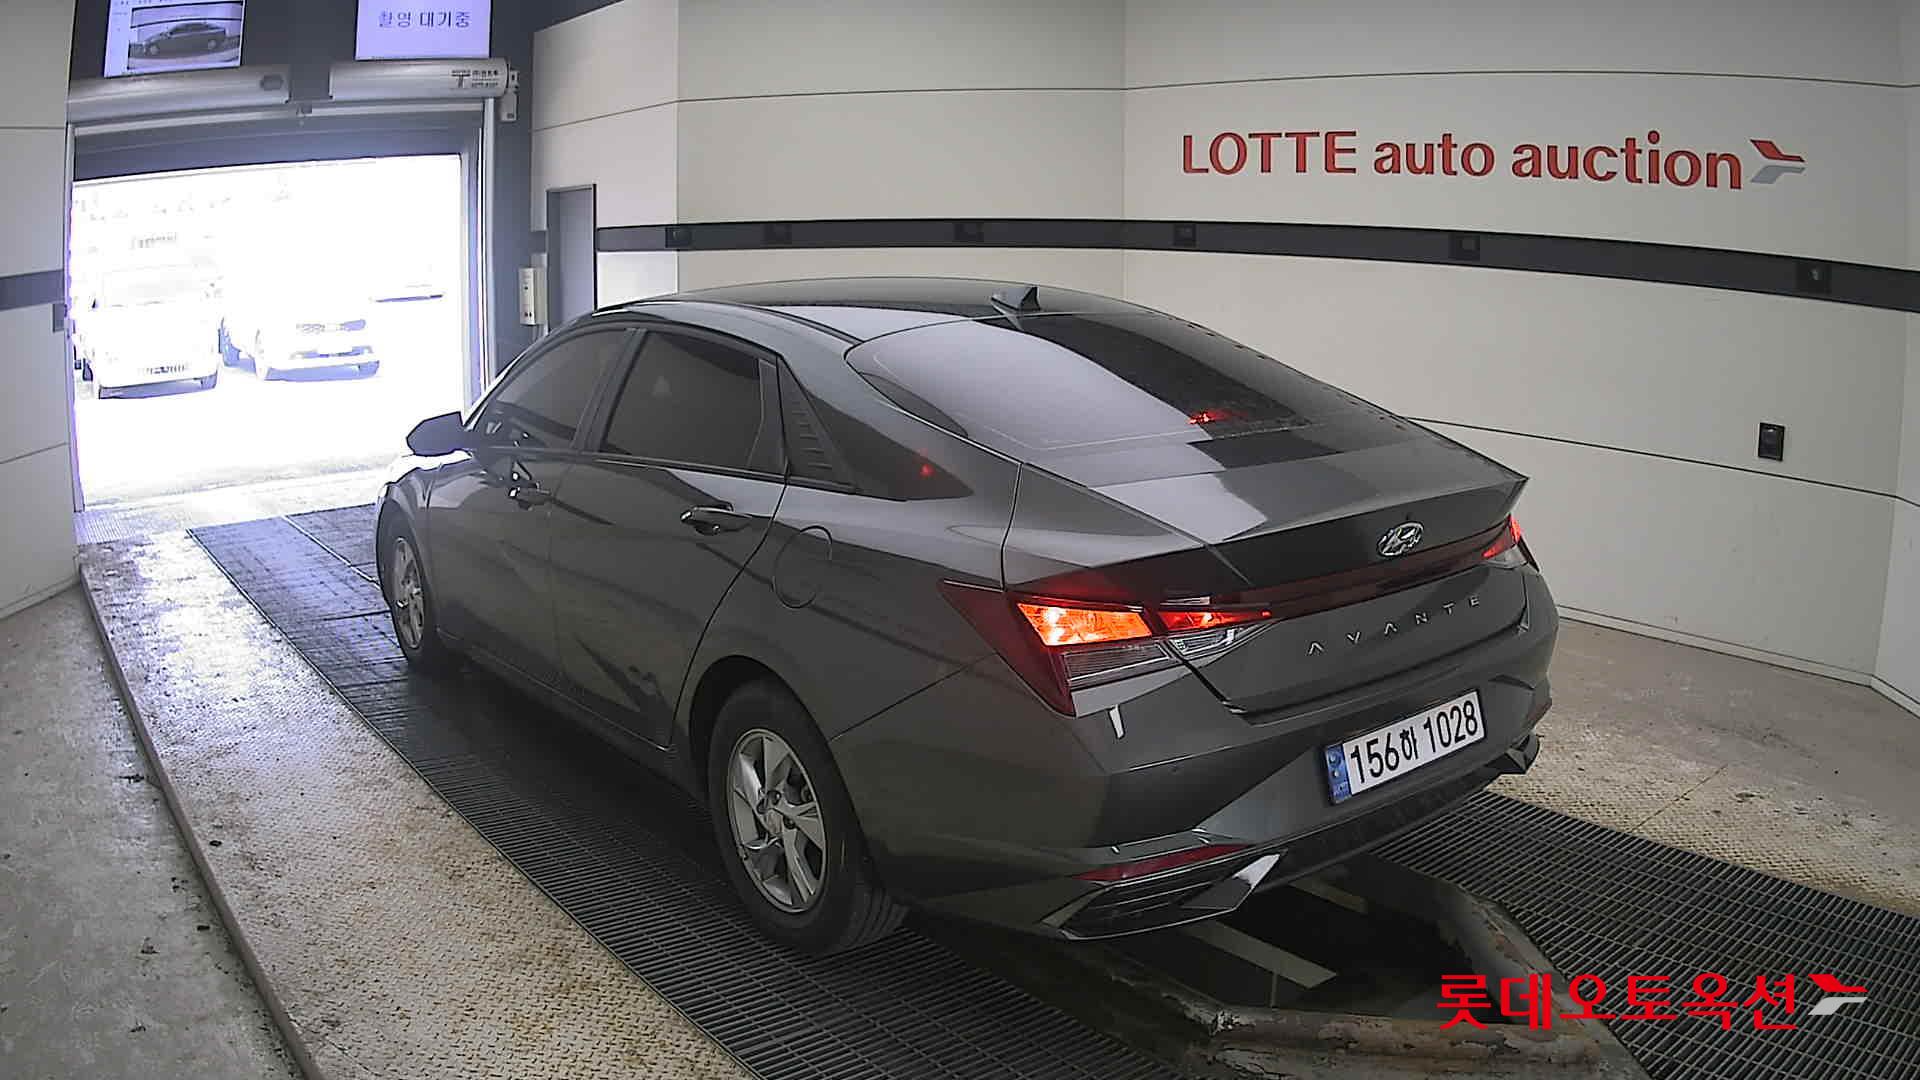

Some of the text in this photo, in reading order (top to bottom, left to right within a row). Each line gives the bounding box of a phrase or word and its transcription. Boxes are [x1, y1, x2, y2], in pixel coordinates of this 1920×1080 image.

[419, 10, 471, 28] 대기중
[1183, 130, 1742, 189] LOTTE auto auction
[1308, 594, 1481, 655] AVANTE
[1350, 700, 1478, 784] 156하 1028
